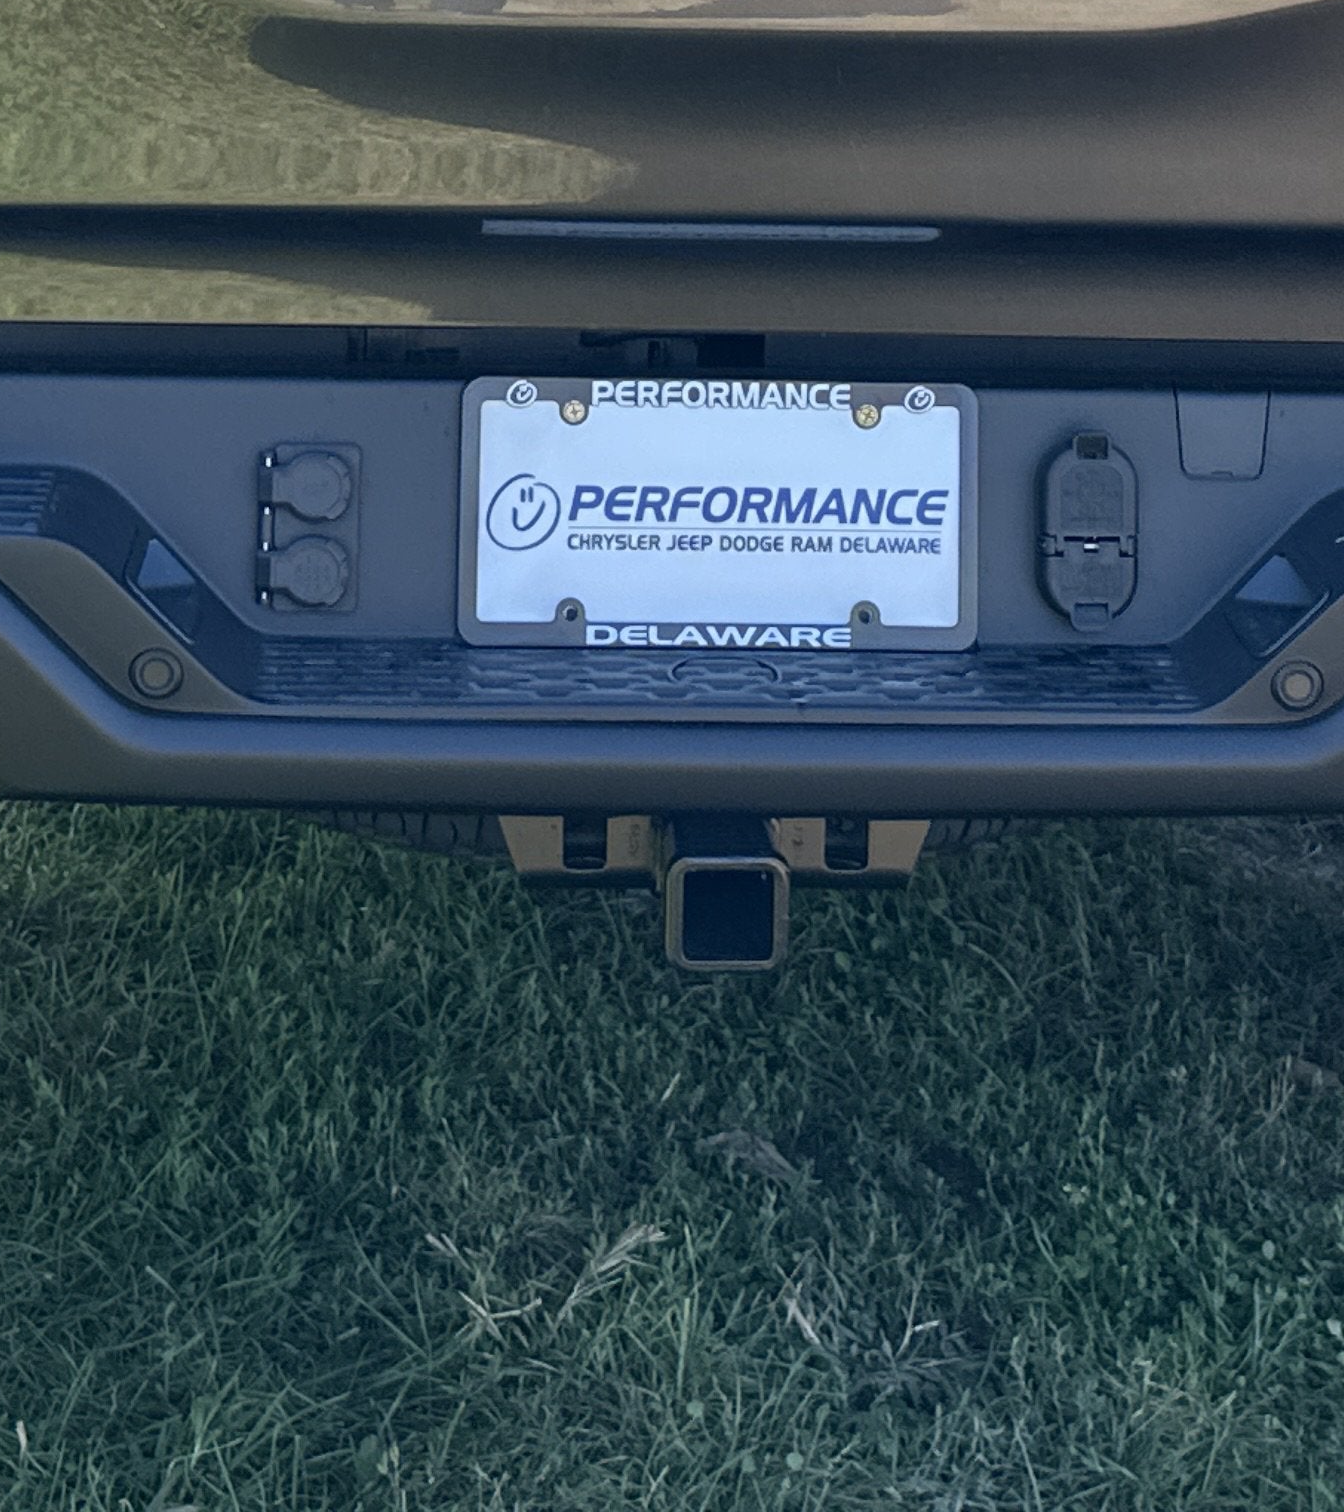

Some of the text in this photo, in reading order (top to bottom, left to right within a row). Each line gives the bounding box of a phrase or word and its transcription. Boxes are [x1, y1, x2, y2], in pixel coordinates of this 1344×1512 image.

[591, 380, 852, 411] PERFORMANCE
[568, 485, 949, 526] PERFORMANCE
[567, 533, 942, 555] CHRYSLER JEEP DODGE RAM DELAWARE
[585, 624, 852, 648] DELAWARE
